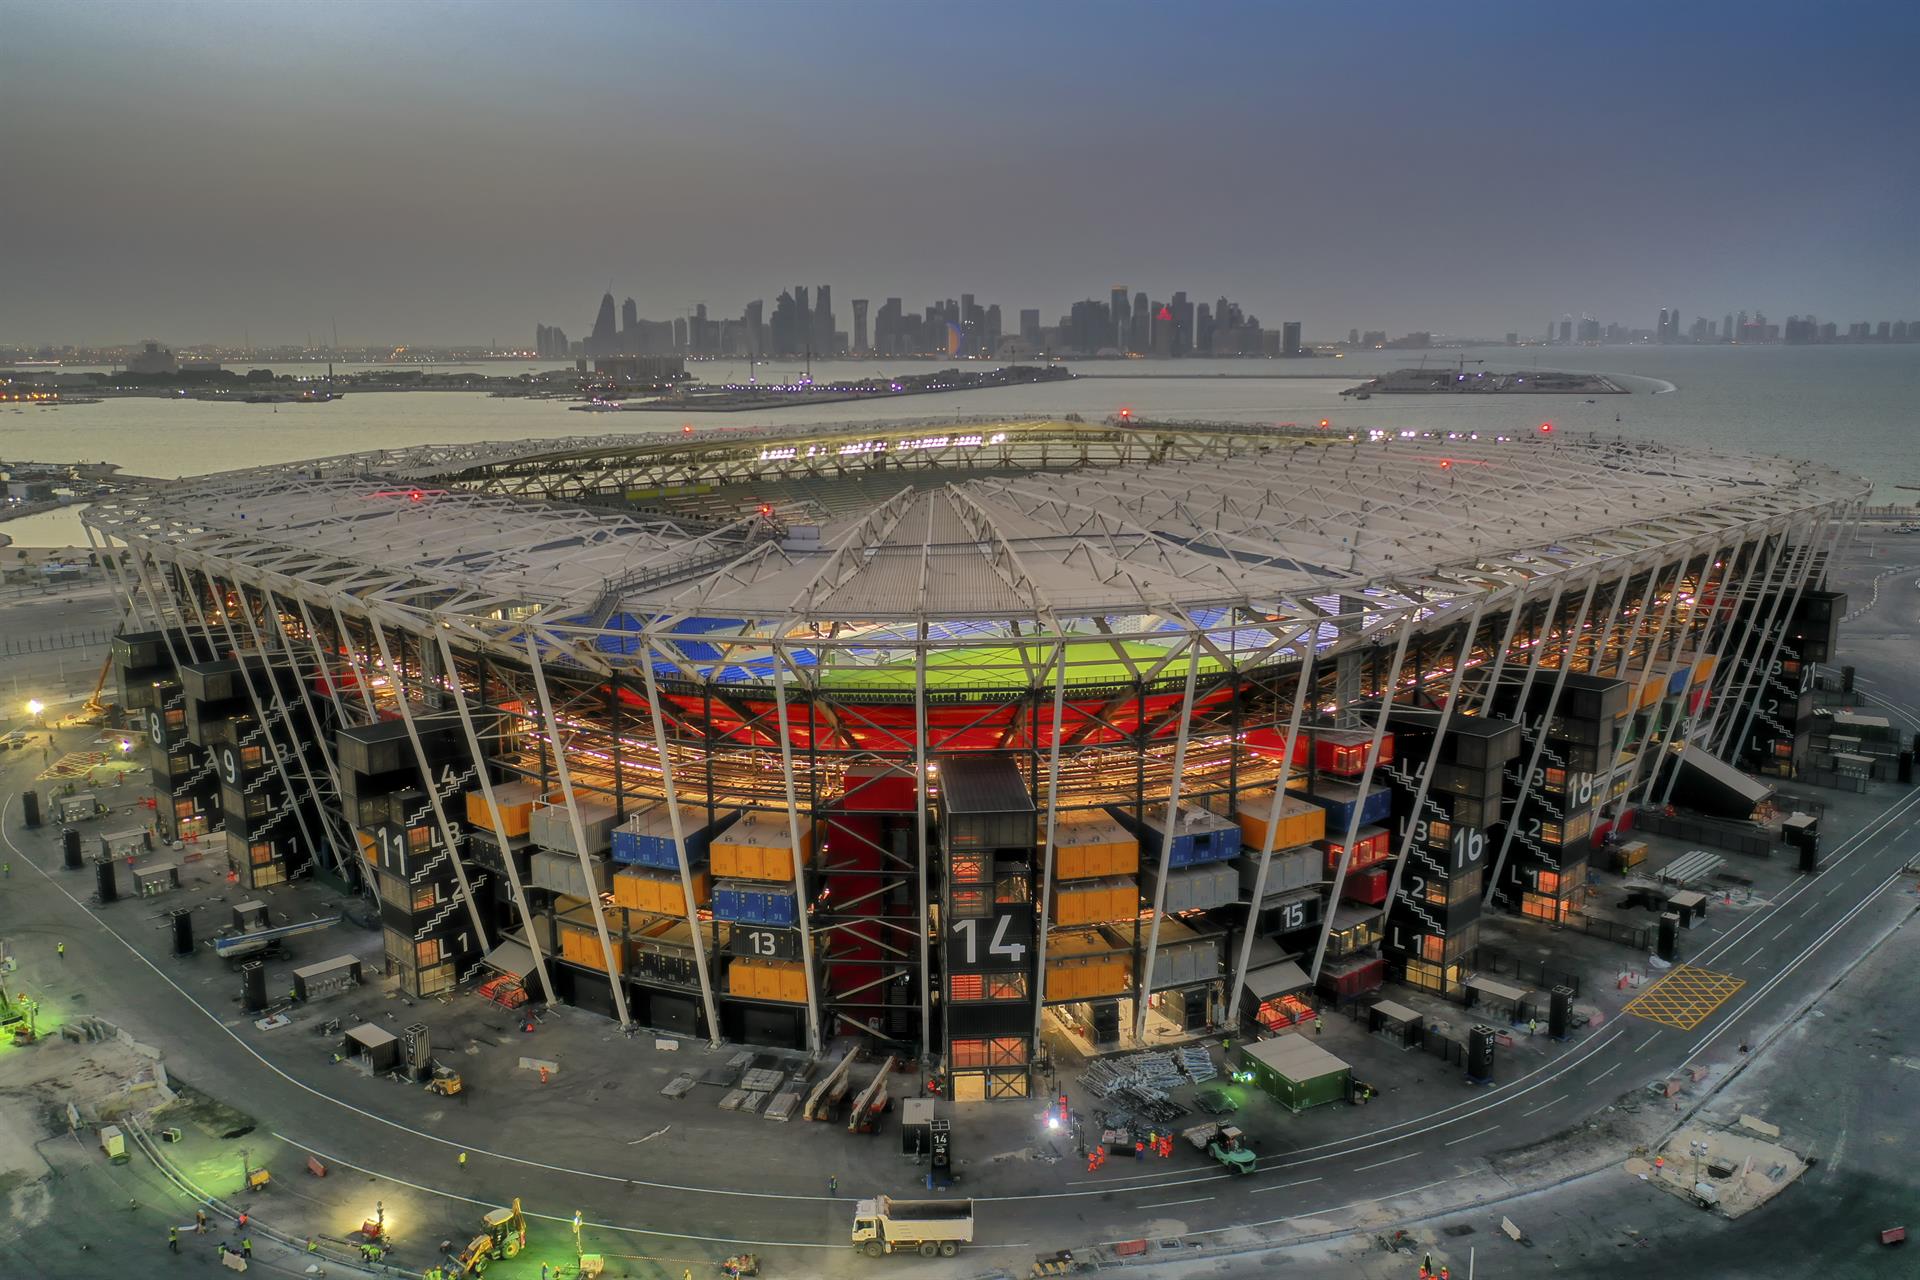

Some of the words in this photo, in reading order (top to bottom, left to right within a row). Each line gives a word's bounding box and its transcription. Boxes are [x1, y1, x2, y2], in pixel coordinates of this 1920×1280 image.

[1760, 659, 1782, 675] L3
[1801, 662, 1816, 693] 21
[150, 712, 162, 744] 8
[262, 743, 289, 764] L3
[1753, 736, 1775, 753] L1
[189, 751, 218, 770] L2
[223, 749, 236, 784] 9
[1518, 764, 1544, 787] L3
[266, 791, 295, 812] L2
[1569, 771, 1594, 808] 18
[194, 793, 219, 812] L1
[431, 822, 460, 848] L3
[1400, 816, 1427, 841] L3
[271, 837, 298, 859] L1
[378, 827, 406, 876] 11
[1454, 828, 1484, 868] 16
[1512, 865, 1537, 888] L1
[434, 879, 465, 904] L2
[1282, 903, 1304, 928] 15
[439, 932, 469, 959] L1
[749, 932, 776, 955] 13
[953, 914, 1026, 963] 14
[1394, 927, 1422, 954] L1
[934, 1135, 947, 1144] 14
